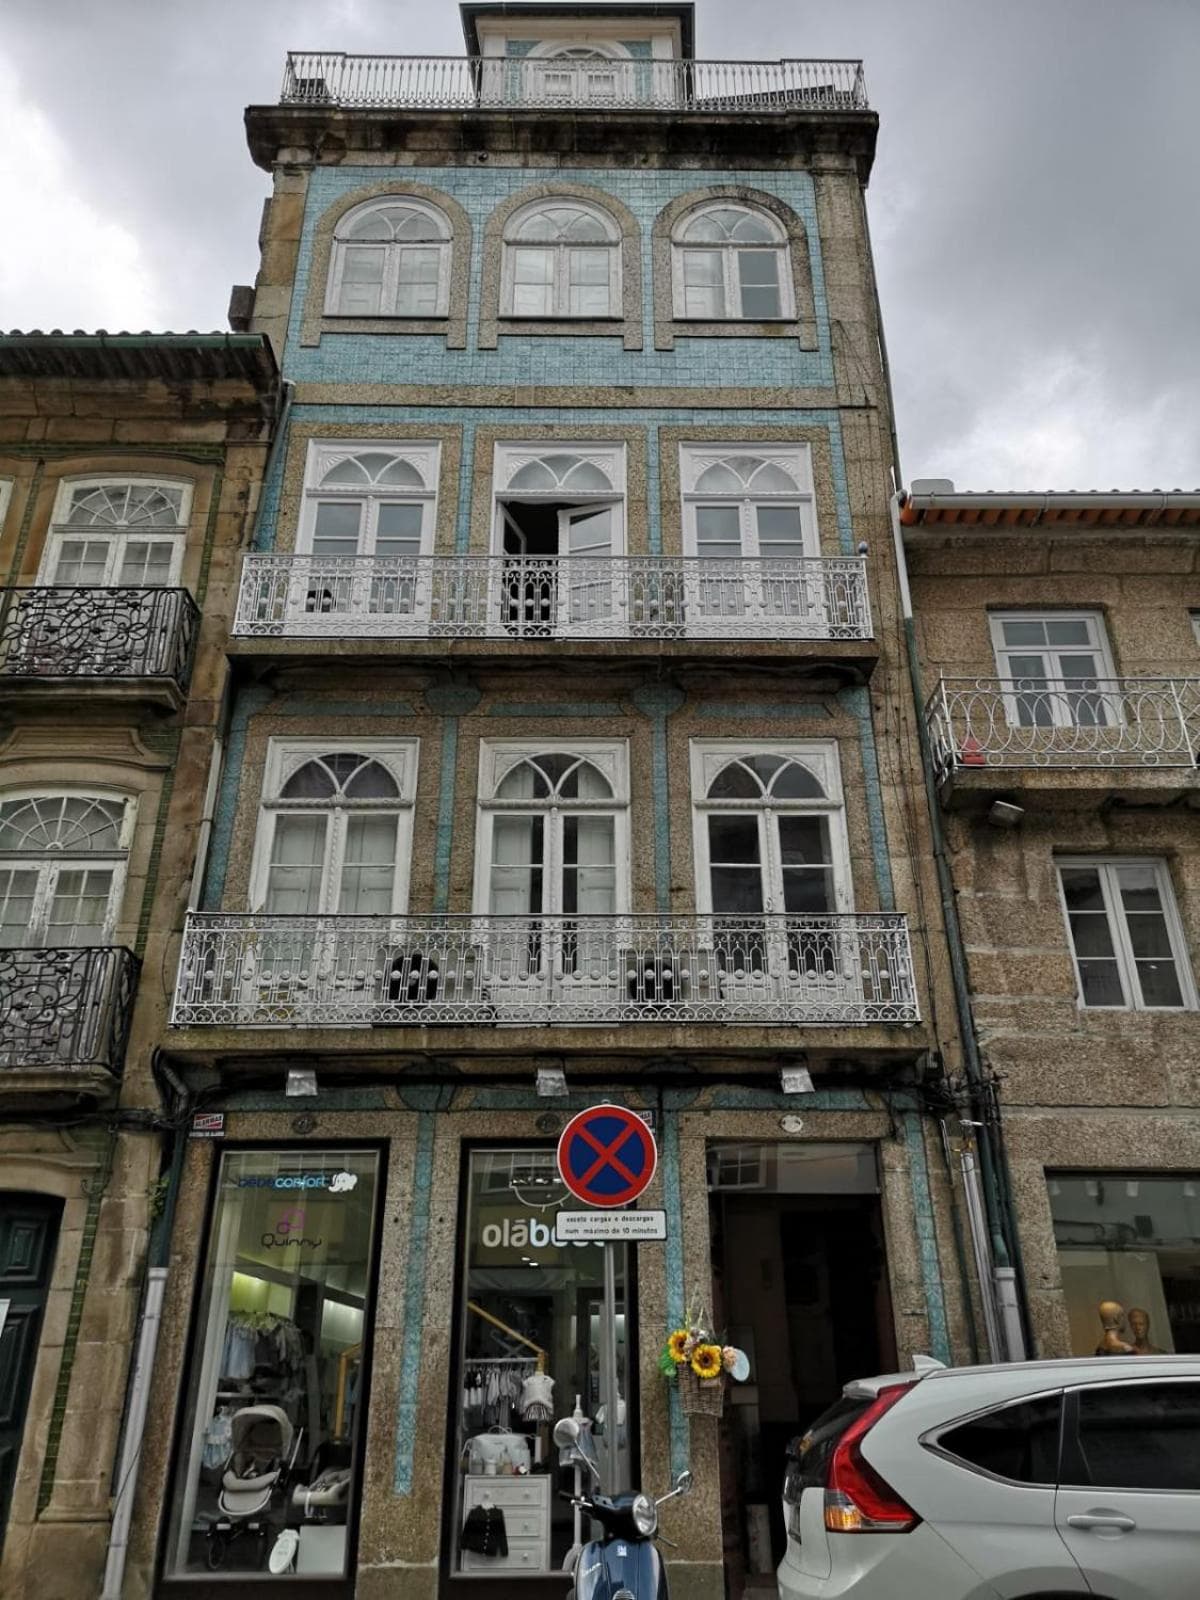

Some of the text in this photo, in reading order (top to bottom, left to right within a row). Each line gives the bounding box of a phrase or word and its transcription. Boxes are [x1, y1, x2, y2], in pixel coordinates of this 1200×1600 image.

[590, 1216, 612, 1224] cargas
[621, 1215, 654, 1224] descargas
[261, 1233, 322, 1249] Quinny
